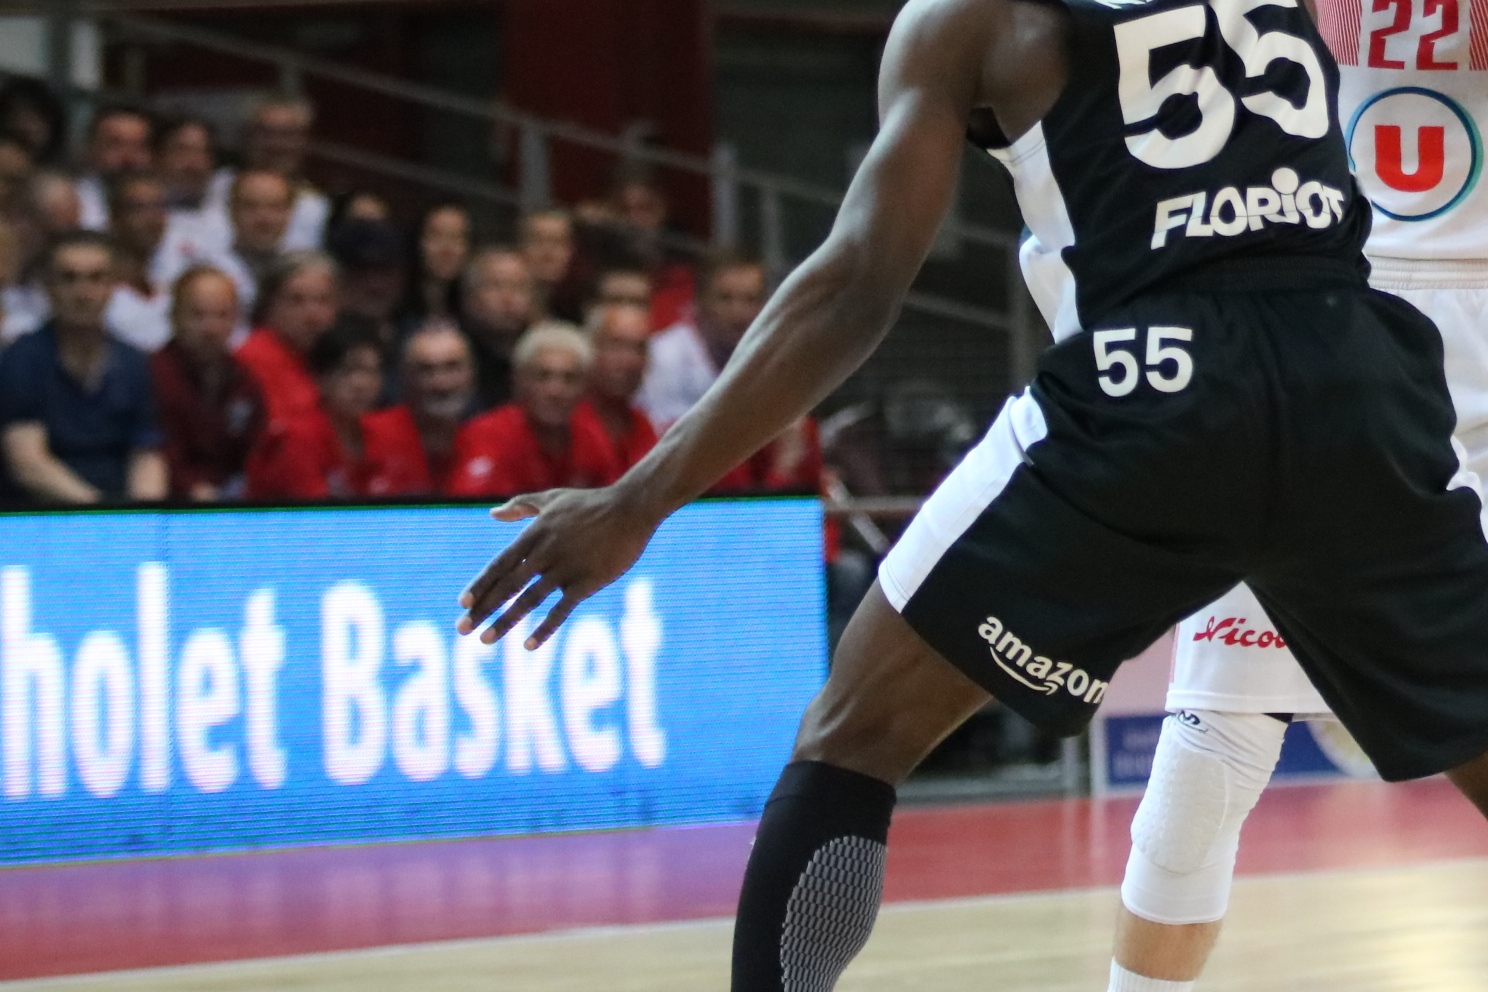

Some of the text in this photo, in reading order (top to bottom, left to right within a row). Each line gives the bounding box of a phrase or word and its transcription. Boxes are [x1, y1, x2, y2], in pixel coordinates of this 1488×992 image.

[1374, 124, 1445, 193] U
[1093, 326, 1194, 398] 55
[0, 561, 667, 801] holet Basket
[978, 616, 1108, 705] amazon
